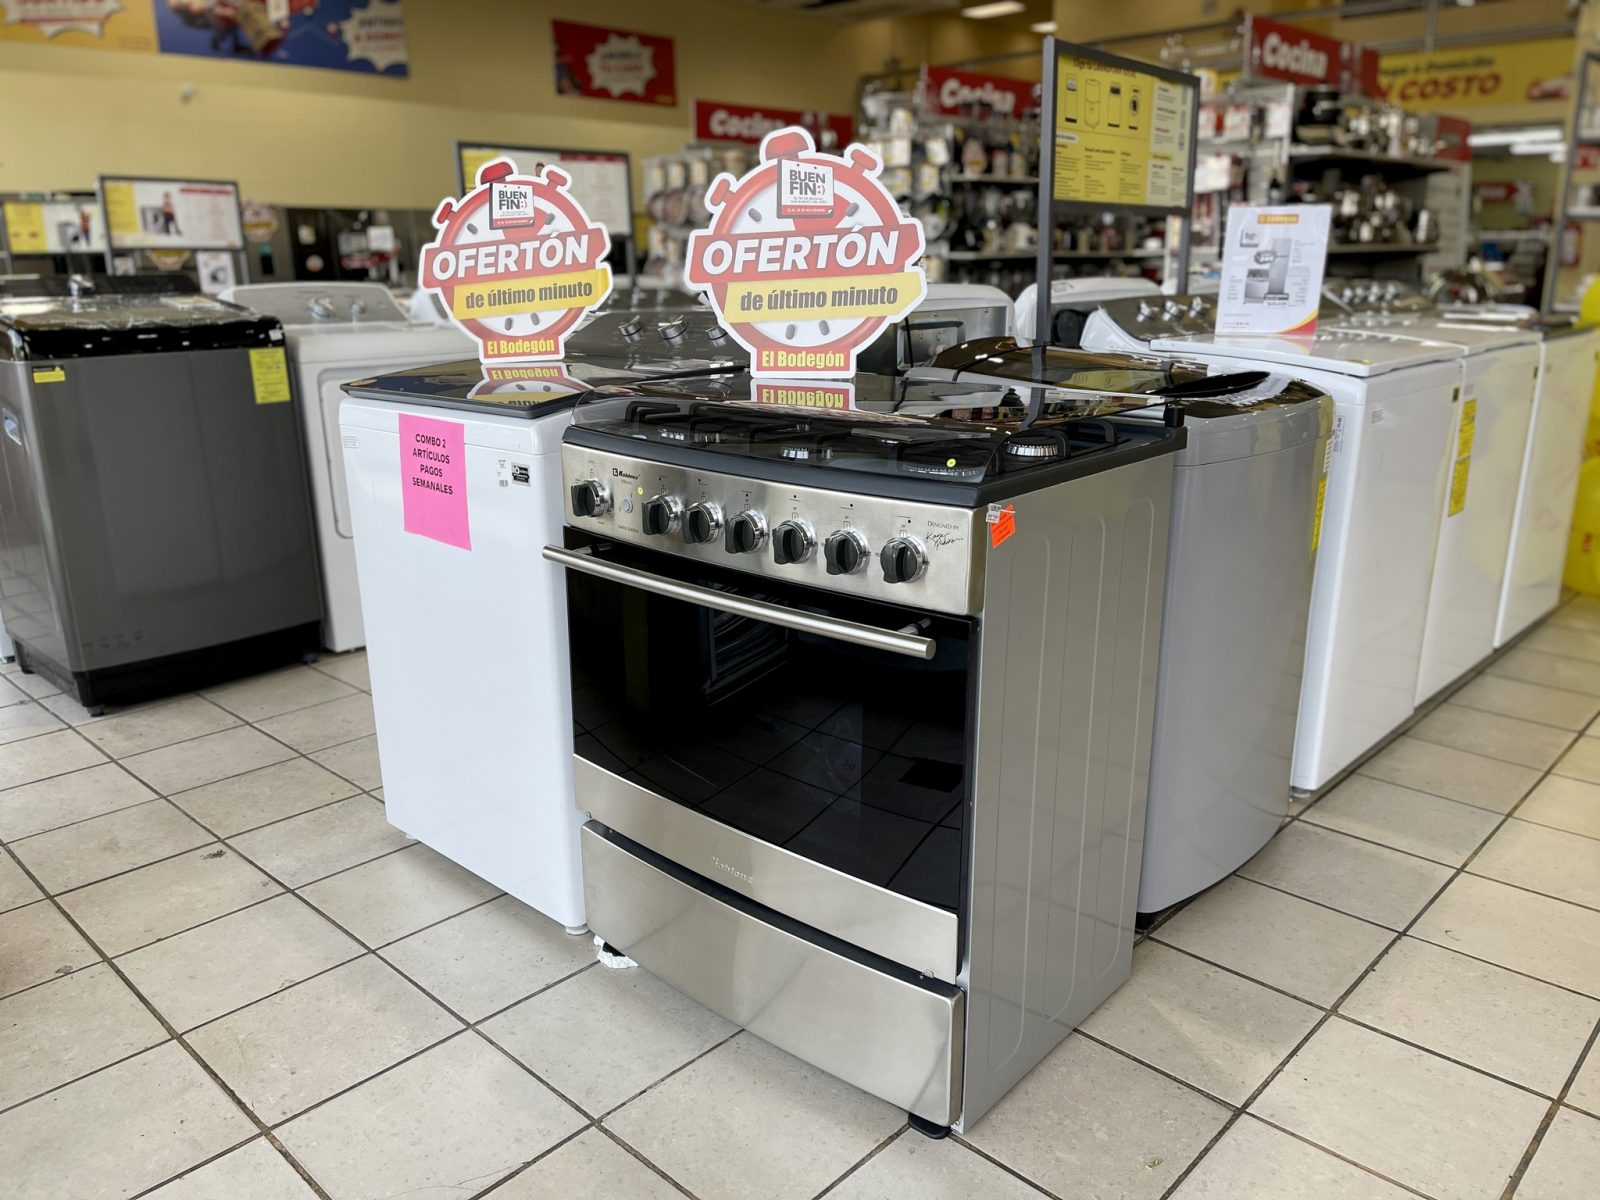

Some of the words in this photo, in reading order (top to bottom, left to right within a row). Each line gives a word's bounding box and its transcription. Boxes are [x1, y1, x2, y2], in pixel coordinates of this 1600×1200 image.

[1263, 32, 1328, 79] Cocina
[1400, 73, 1502, 101] COSTO
[789, 169, 826, 184] BUEN
[498, 190, 528, 200] BUEN
[432, 231, 589, 281] OFERTÓN
[702, 225, 899, 275] OFERTÓN
[465, 292, 484, 310] de
[488, 284, 536, 307] último
[539, 280, 593, 301] minuto
[740, 291, 763, 312] de
[767, 289, 828, 310] último
[831, 286, 898, 308] minuto
[487, 342, 498, 355] El
[500, 339, 555, 355] Bodegón
[762, 351, 774, 367] El
[777, 351, 844, 369] Bodegón
[415, 434, 441, 447] COMBO
[441, 438, 446, 448] 2
[412, 448, 450, 464] ARTÍCULOS
[420, 464, 443, 478] PAGOS
[412, 477, 453, 495] SEMANALES
[927, 521, 952, 530] DESIGNED
